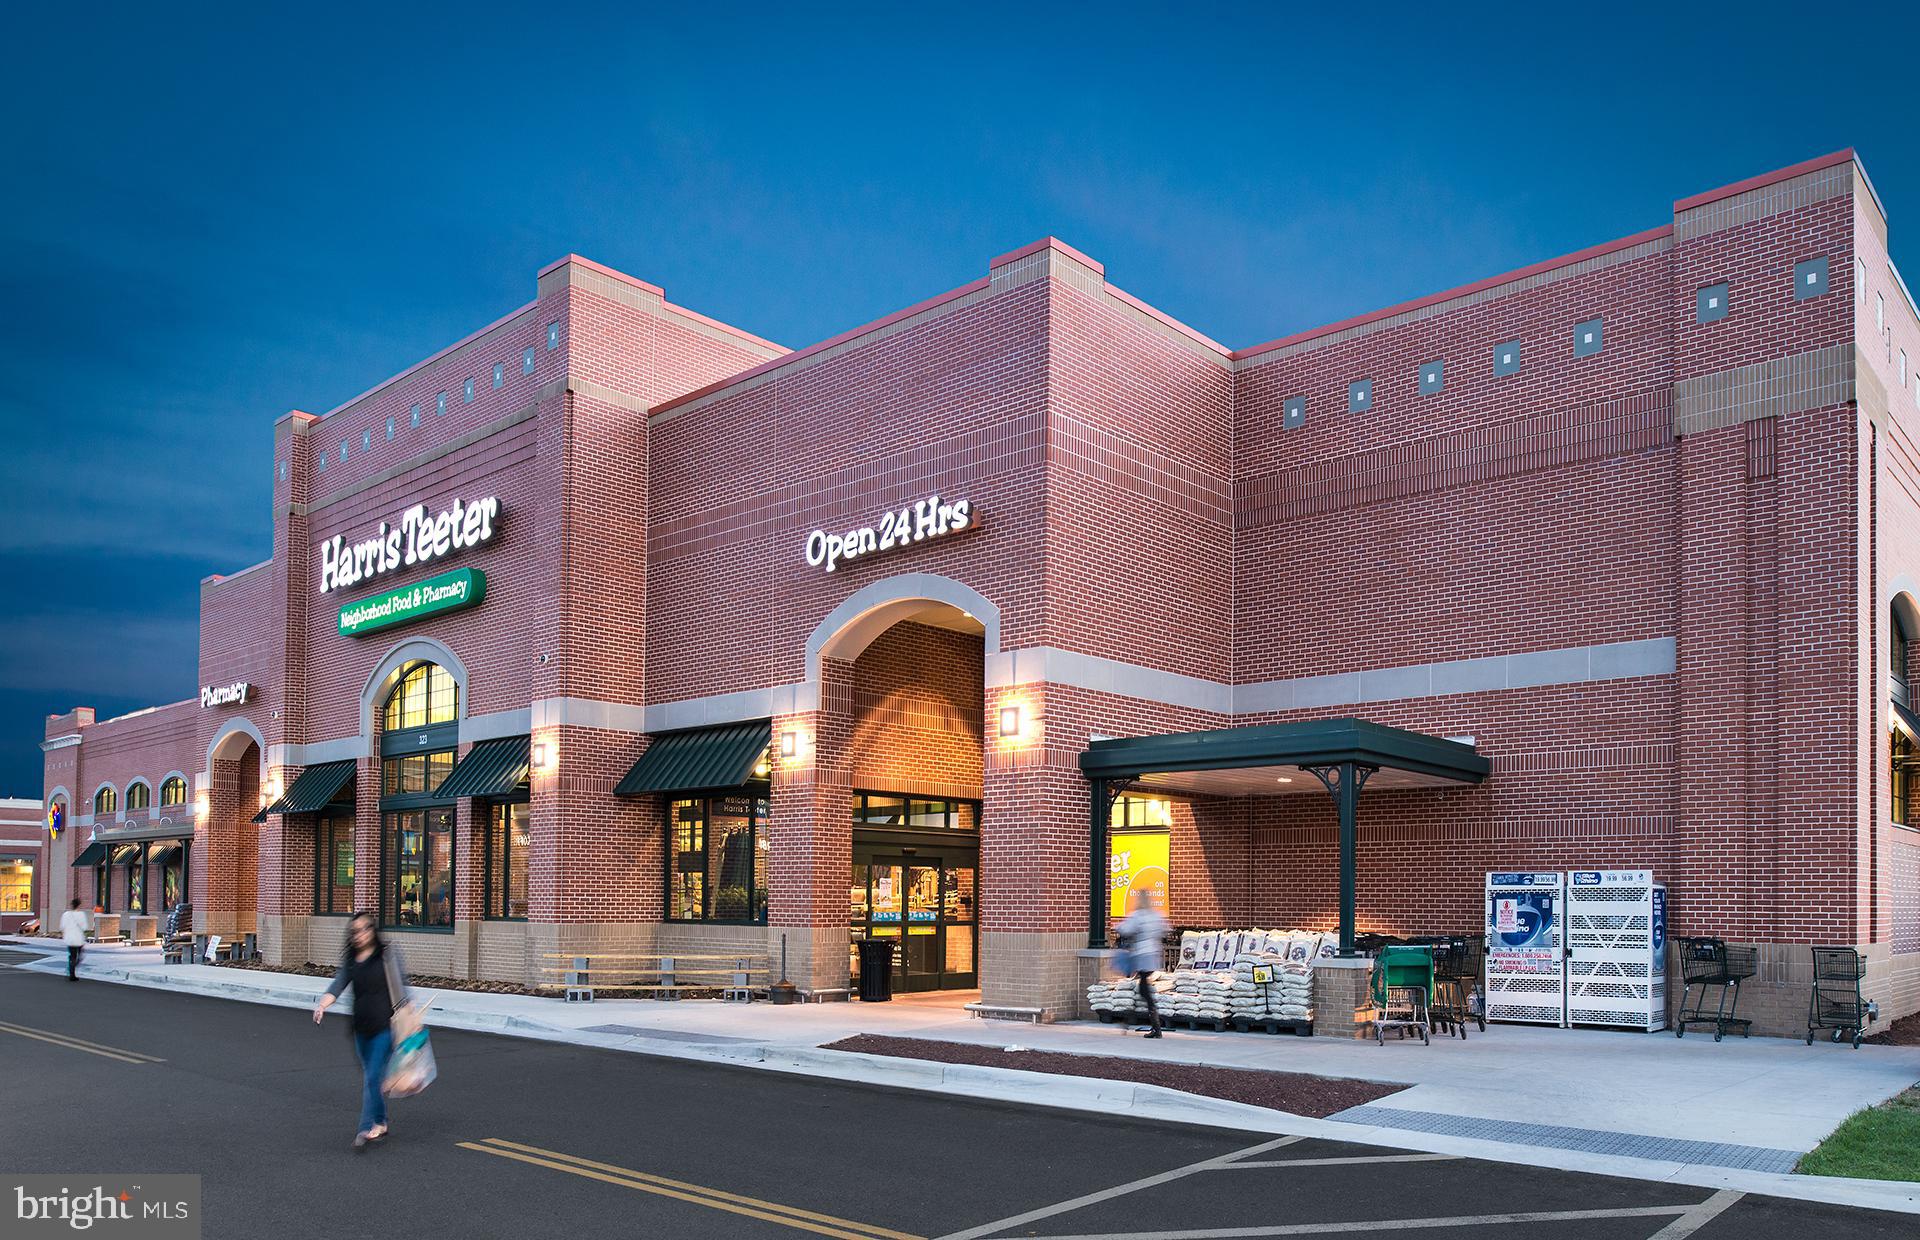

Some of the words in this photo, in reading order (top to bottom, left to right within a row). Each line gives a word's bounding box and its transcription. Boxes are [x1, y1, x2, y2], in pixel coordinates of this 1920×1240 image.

[319, 521, 401, 593] Harris
[402, 496, 497, 566] Teeter
[805, 527, 877, 573] Open
[879, 508, 911, 550] 24
[914, 495, 969, 541] Hrs
[340, 596, 391, 629] Neighborhood
[392, 591, 413, 614] Food
[413, 588, 422, 606] &
[422, 580, 468, 606] Pharmacy
[200, 682, 248, 709] Pharmacy
[1111, 850, 1131, 873] er
[1111, 873, 1130, 890] ces
